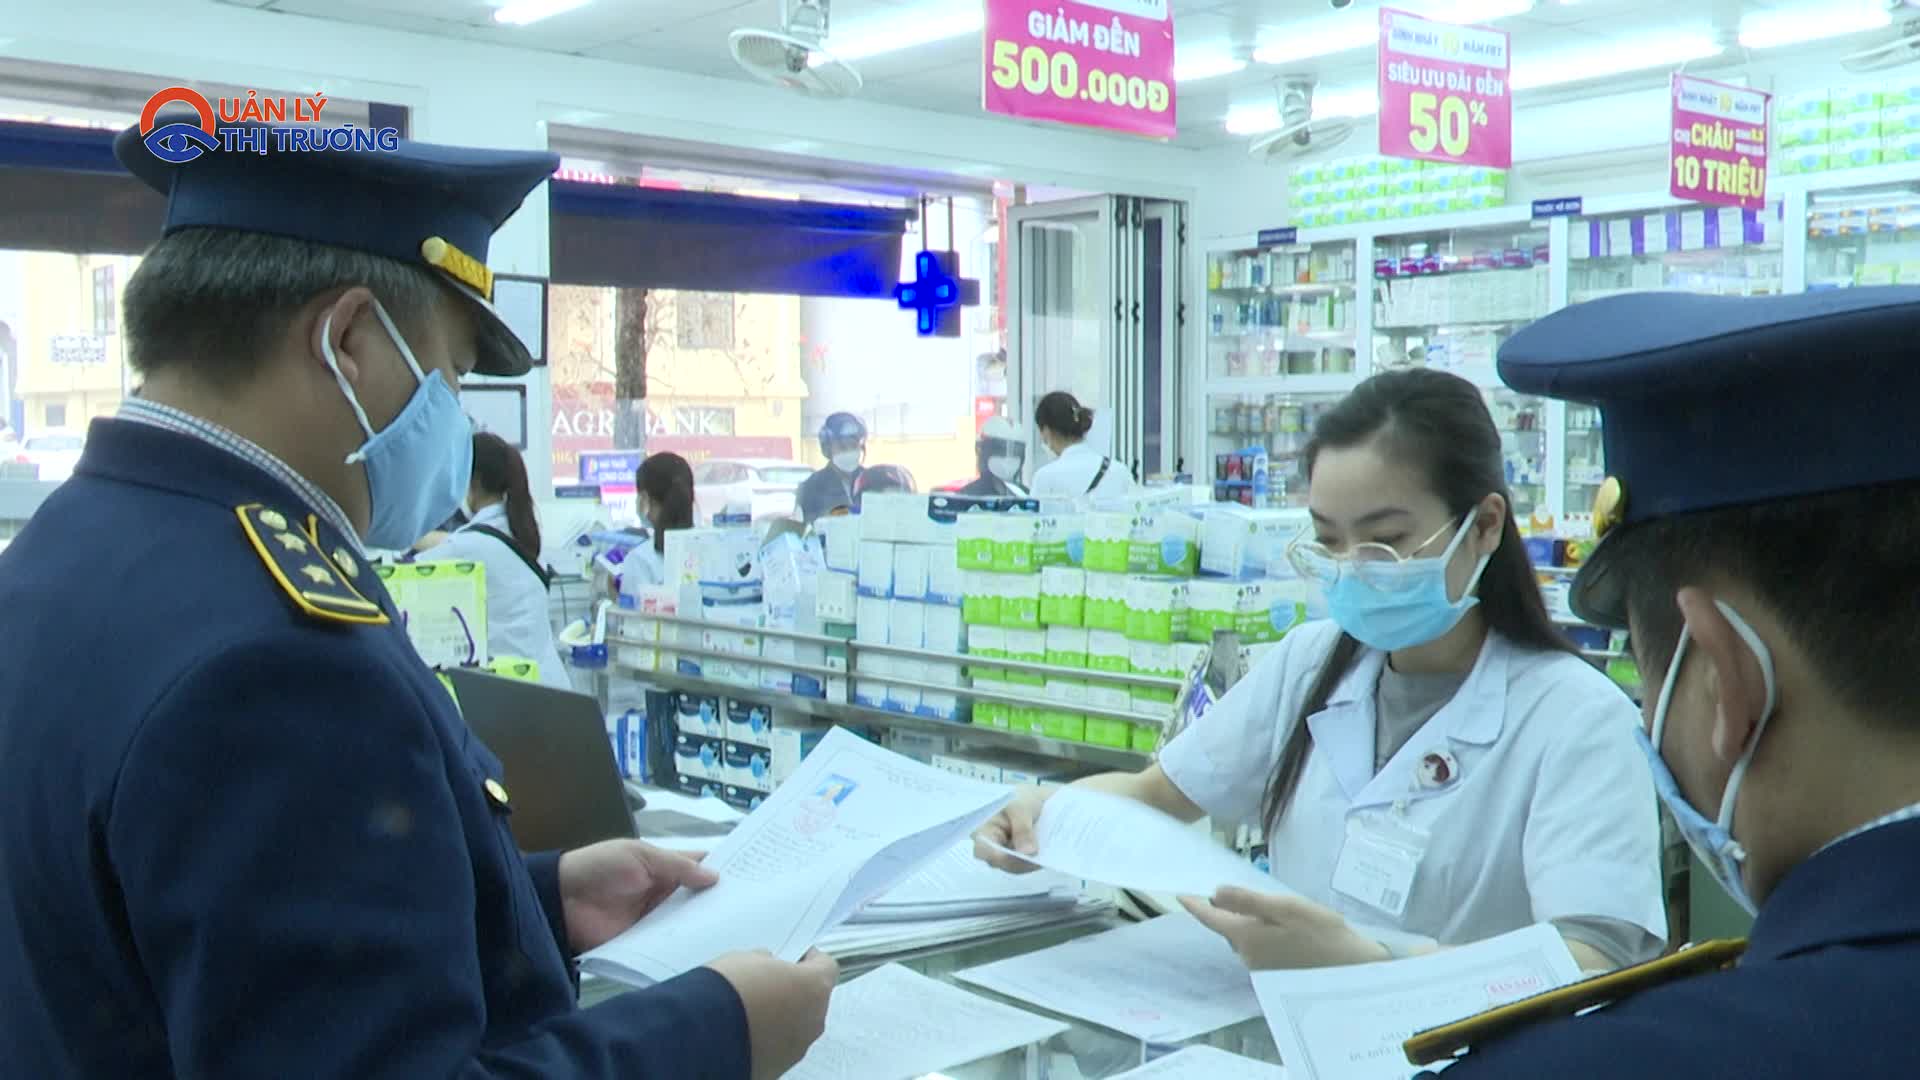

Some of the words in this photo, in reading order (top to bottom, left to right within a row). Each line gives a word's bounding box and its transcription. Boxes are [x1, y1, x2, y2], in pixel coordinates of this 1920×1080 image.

[1028, 8, 1089, 47] GIẢM
[1093, 16, 1140, 57] ĐẾN
[992, 40, 1169, 112] 500.000Đ
[1388, 60, 1419, 85] SIÊU
[1446, 69, 1471, 93] ĐÃI
[1475, 70, 1504, 96] ĐẾN
[1409, 92, 1488, 156] 50%
[1691, 121, 1734, 151] CHÂU
[1675, 155, 1700, 189] 10
[1703, 156, 1764, 205] TRIỆU
